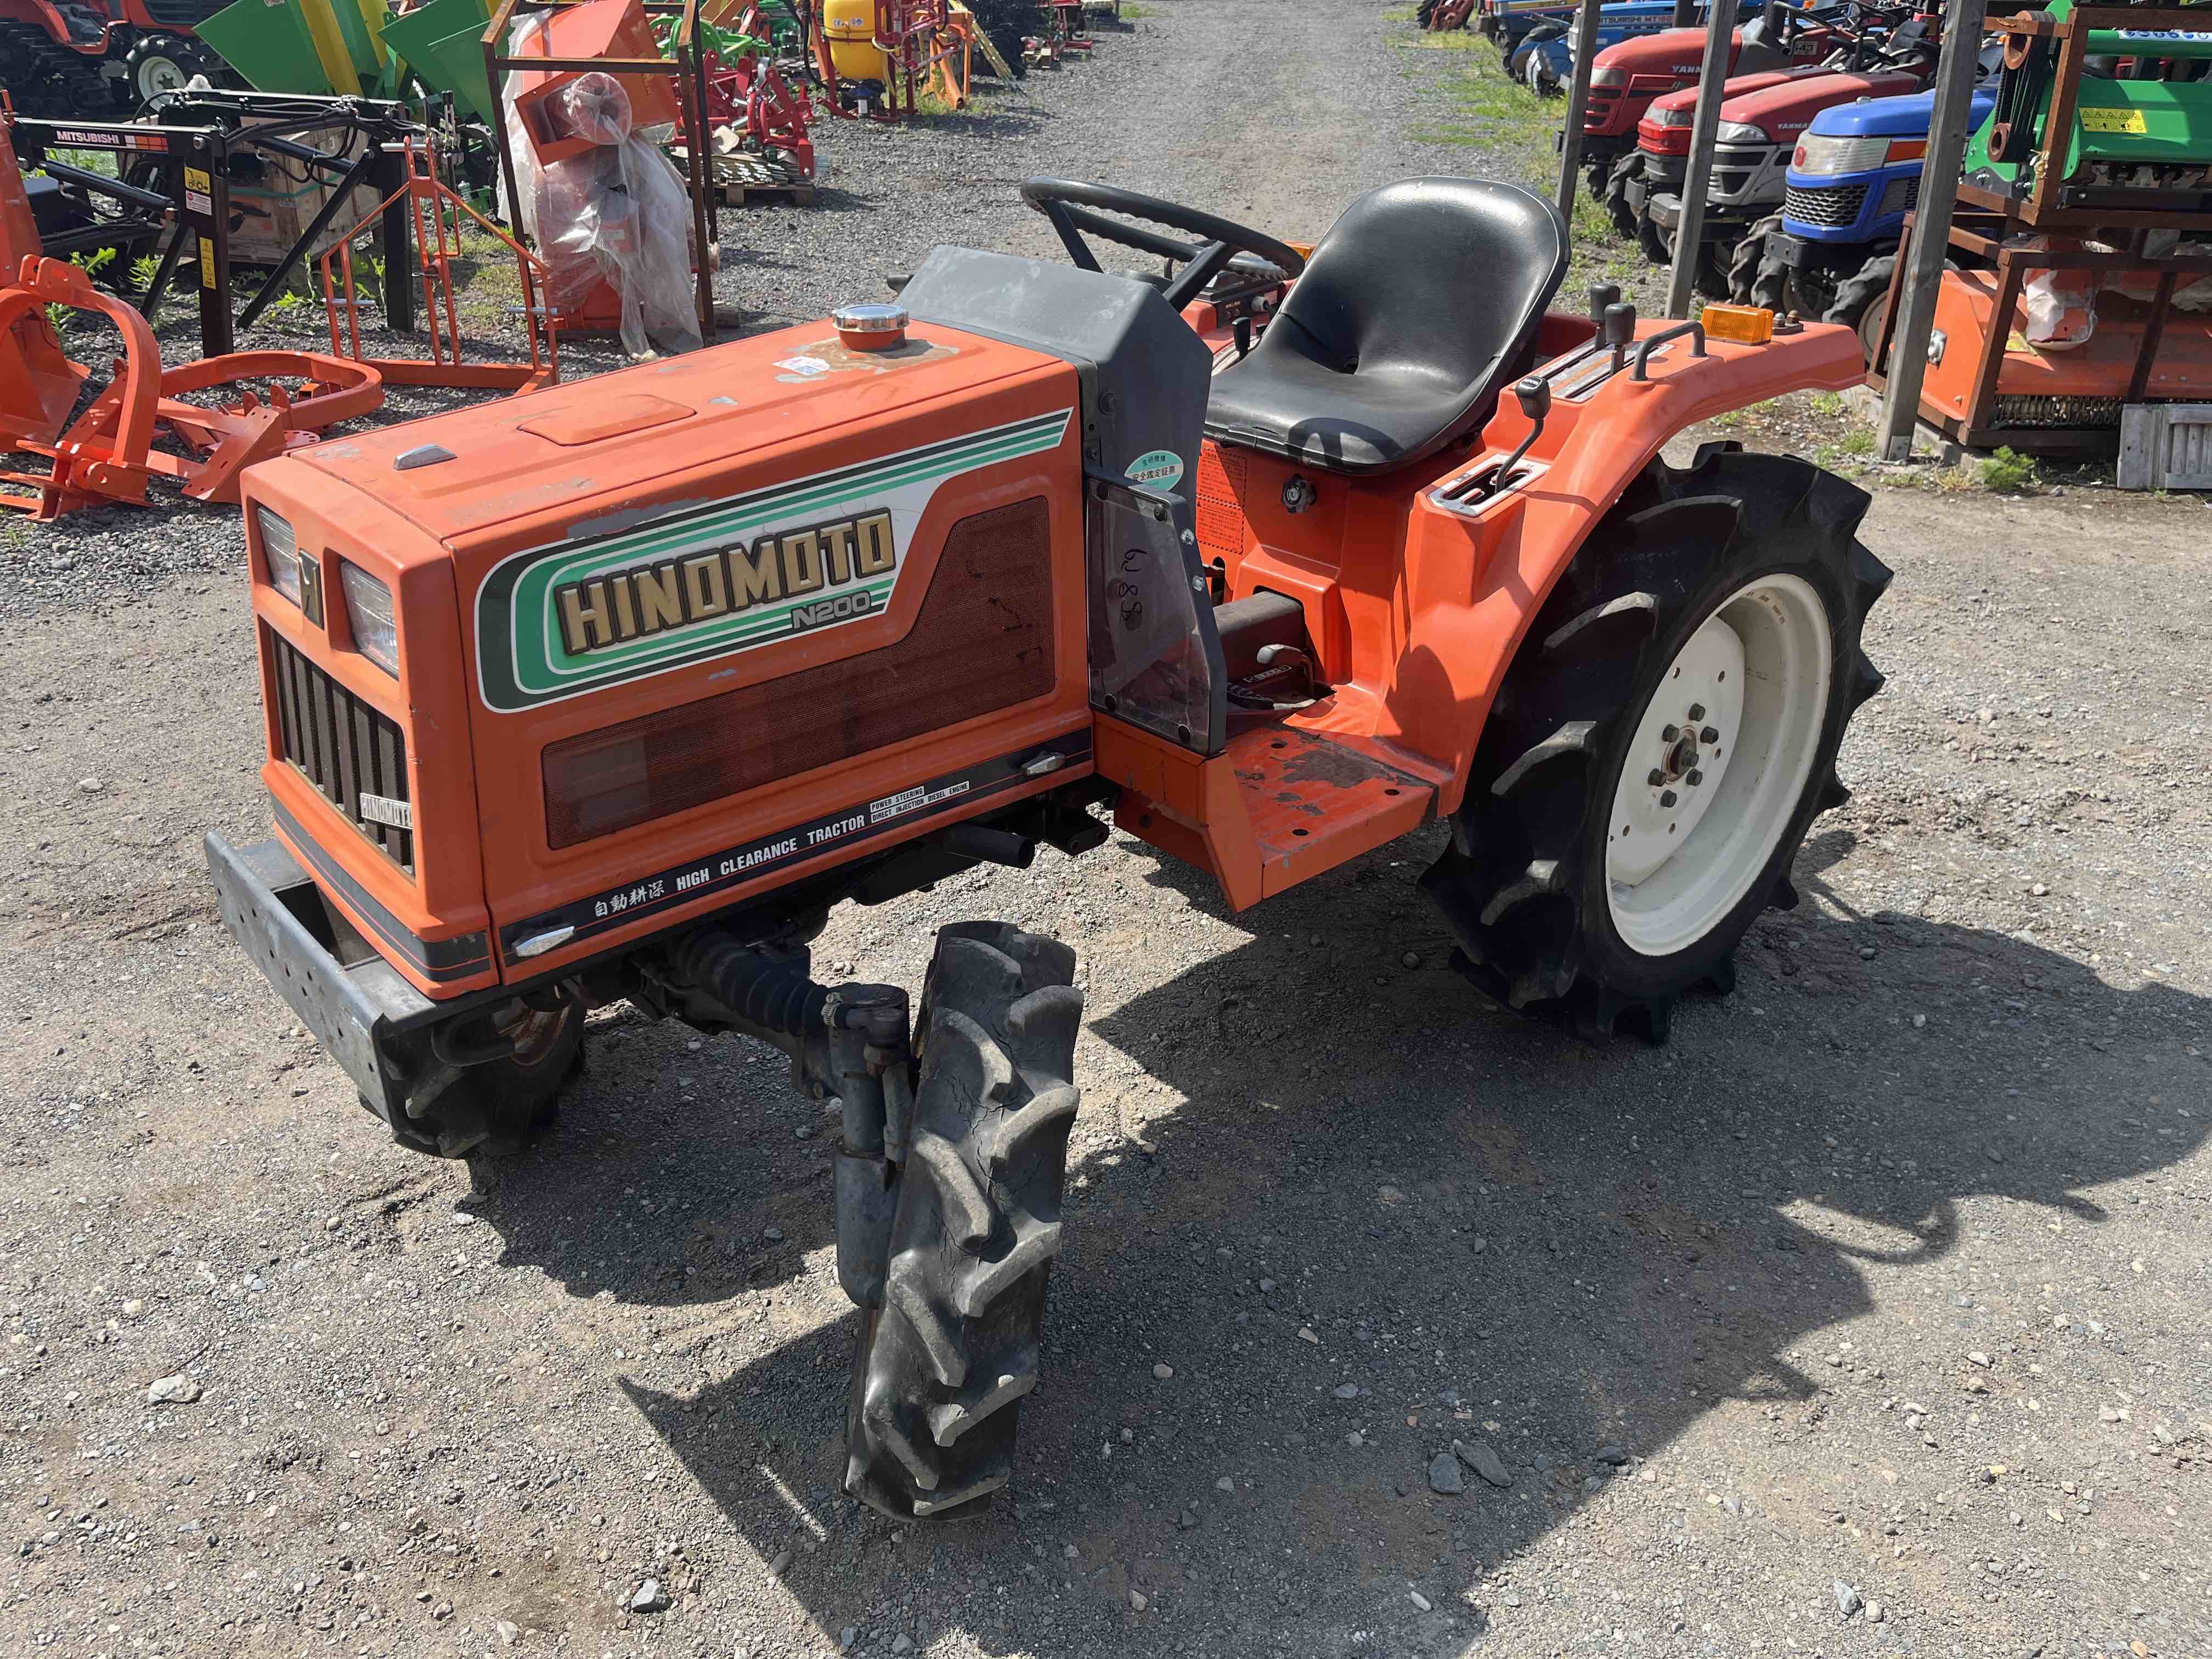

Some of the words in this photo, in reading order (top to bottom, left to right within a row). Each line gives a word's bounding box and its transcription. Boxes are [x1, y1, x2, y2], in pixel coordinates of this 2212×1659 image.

[56, 131, 119, 144] MITSUBISHI
[555, 508, 895, 655] HINOMOTO
[791, 590, 871, 630] N200
[871, 798, 892, 810] POWER
[895, 788, 923, 803] STEERING
[872, 809, 892, 821] DIRECT
[896, 798, 924, 812] INJECTION
[928, 790, 946, 802] DIESEL
[949, 782, 968, 794] ENGINE
[676, 868, 710, 891] HIGH
[720, 838, 798, 876] CLEARANCE
[807, 815, 865, 845] TRACTOR
[594, 879, 665, 917] 自動耕深
